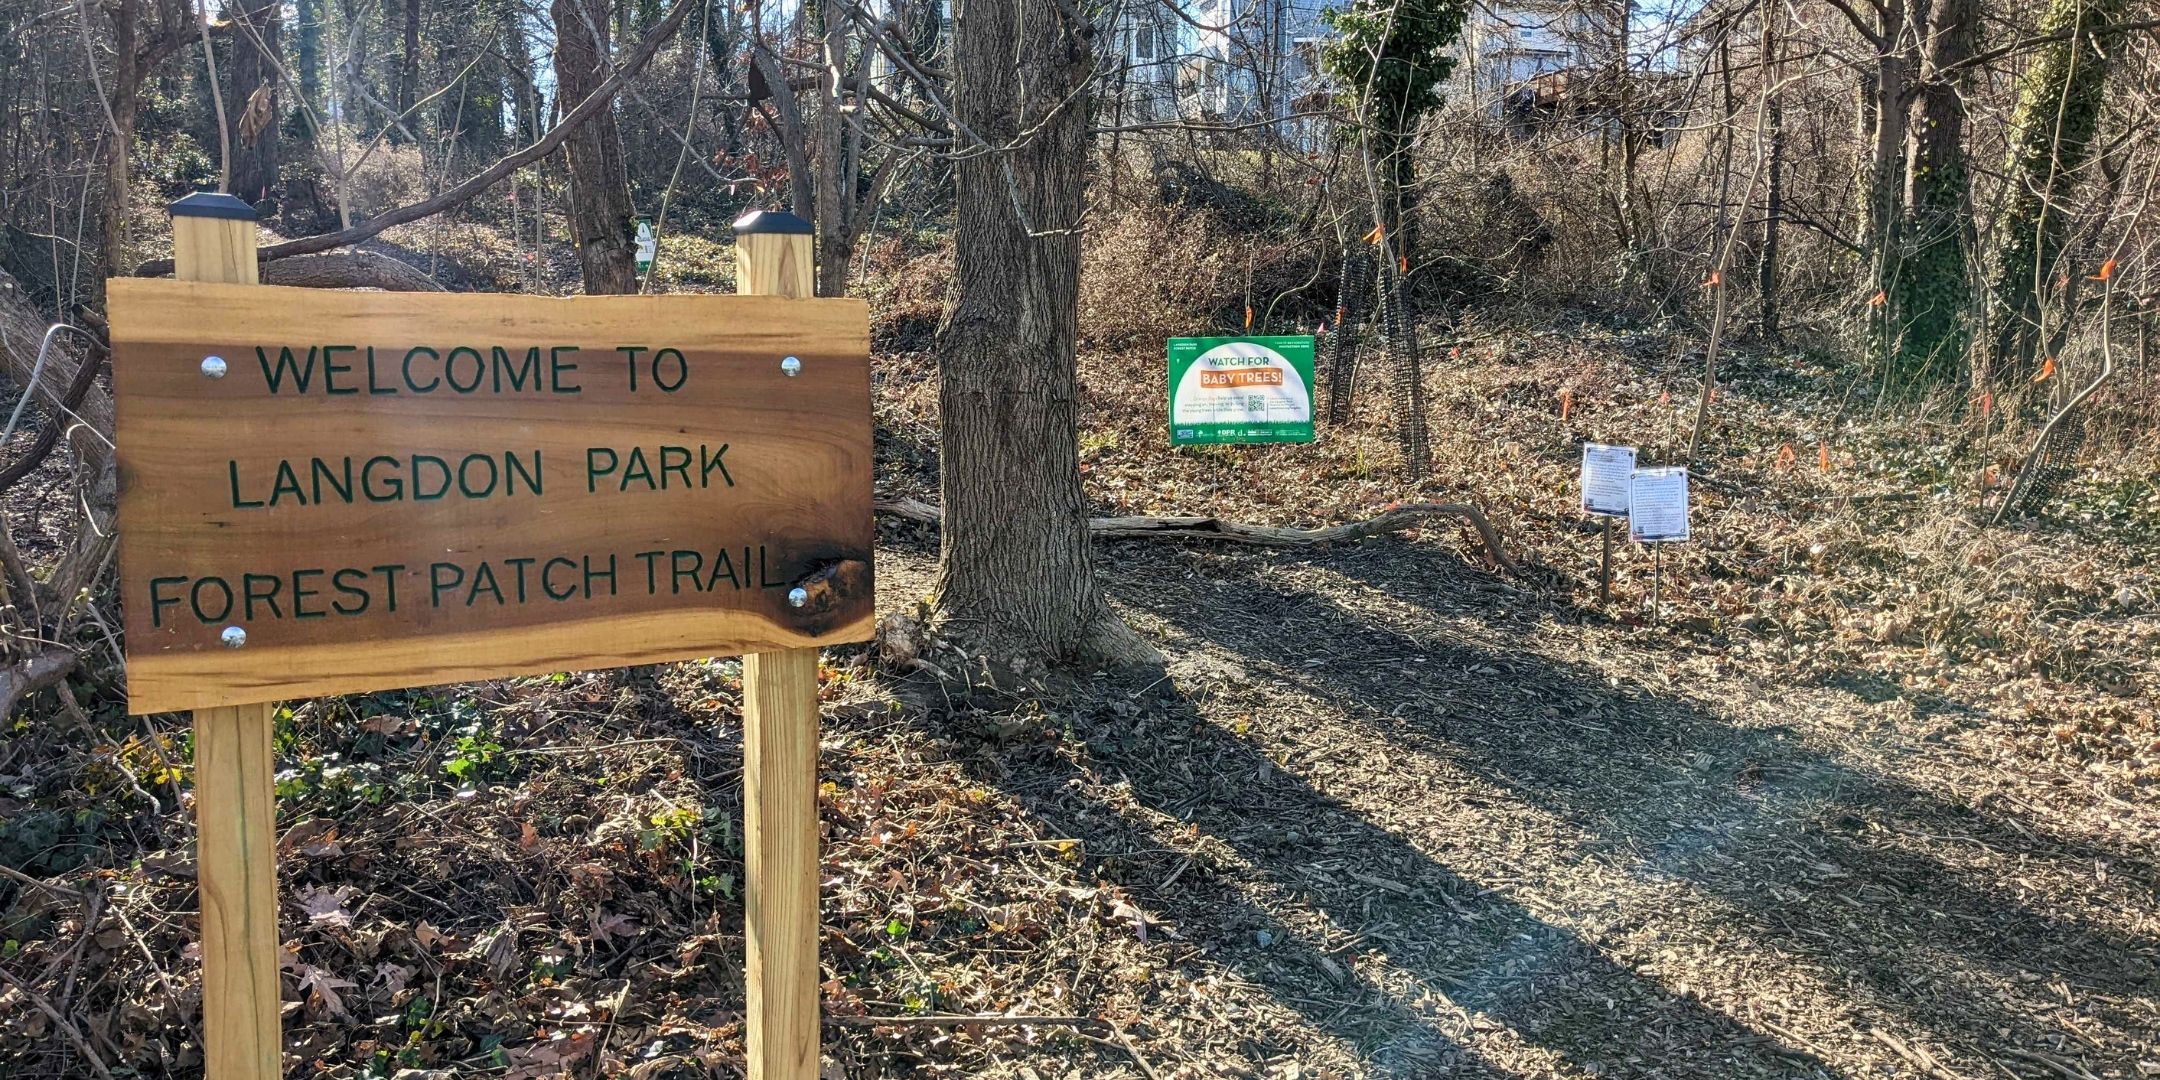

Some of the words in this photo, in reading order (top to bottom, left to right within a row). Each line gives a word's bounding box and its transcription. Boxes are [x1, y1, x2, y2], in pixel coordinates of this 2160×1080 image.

[255, 346, 581, 395] WELCOME
[616, 346, 689, 393] TO
[1202, 373, 1236, 384] BABY
[1238, 372, 1282, 383] TREES!
[1208, 357, 1245, 366] WATCH
[1248, 357, 1270, 365] FOR
[229, 450, 543, 509] LANGDON
[587, 443, 734, 493] PARK
[149, 564, 405, 628] FOREST
[429, 553, 617, 608] PATCH
[636, 545, 788, 595] TRAIL
